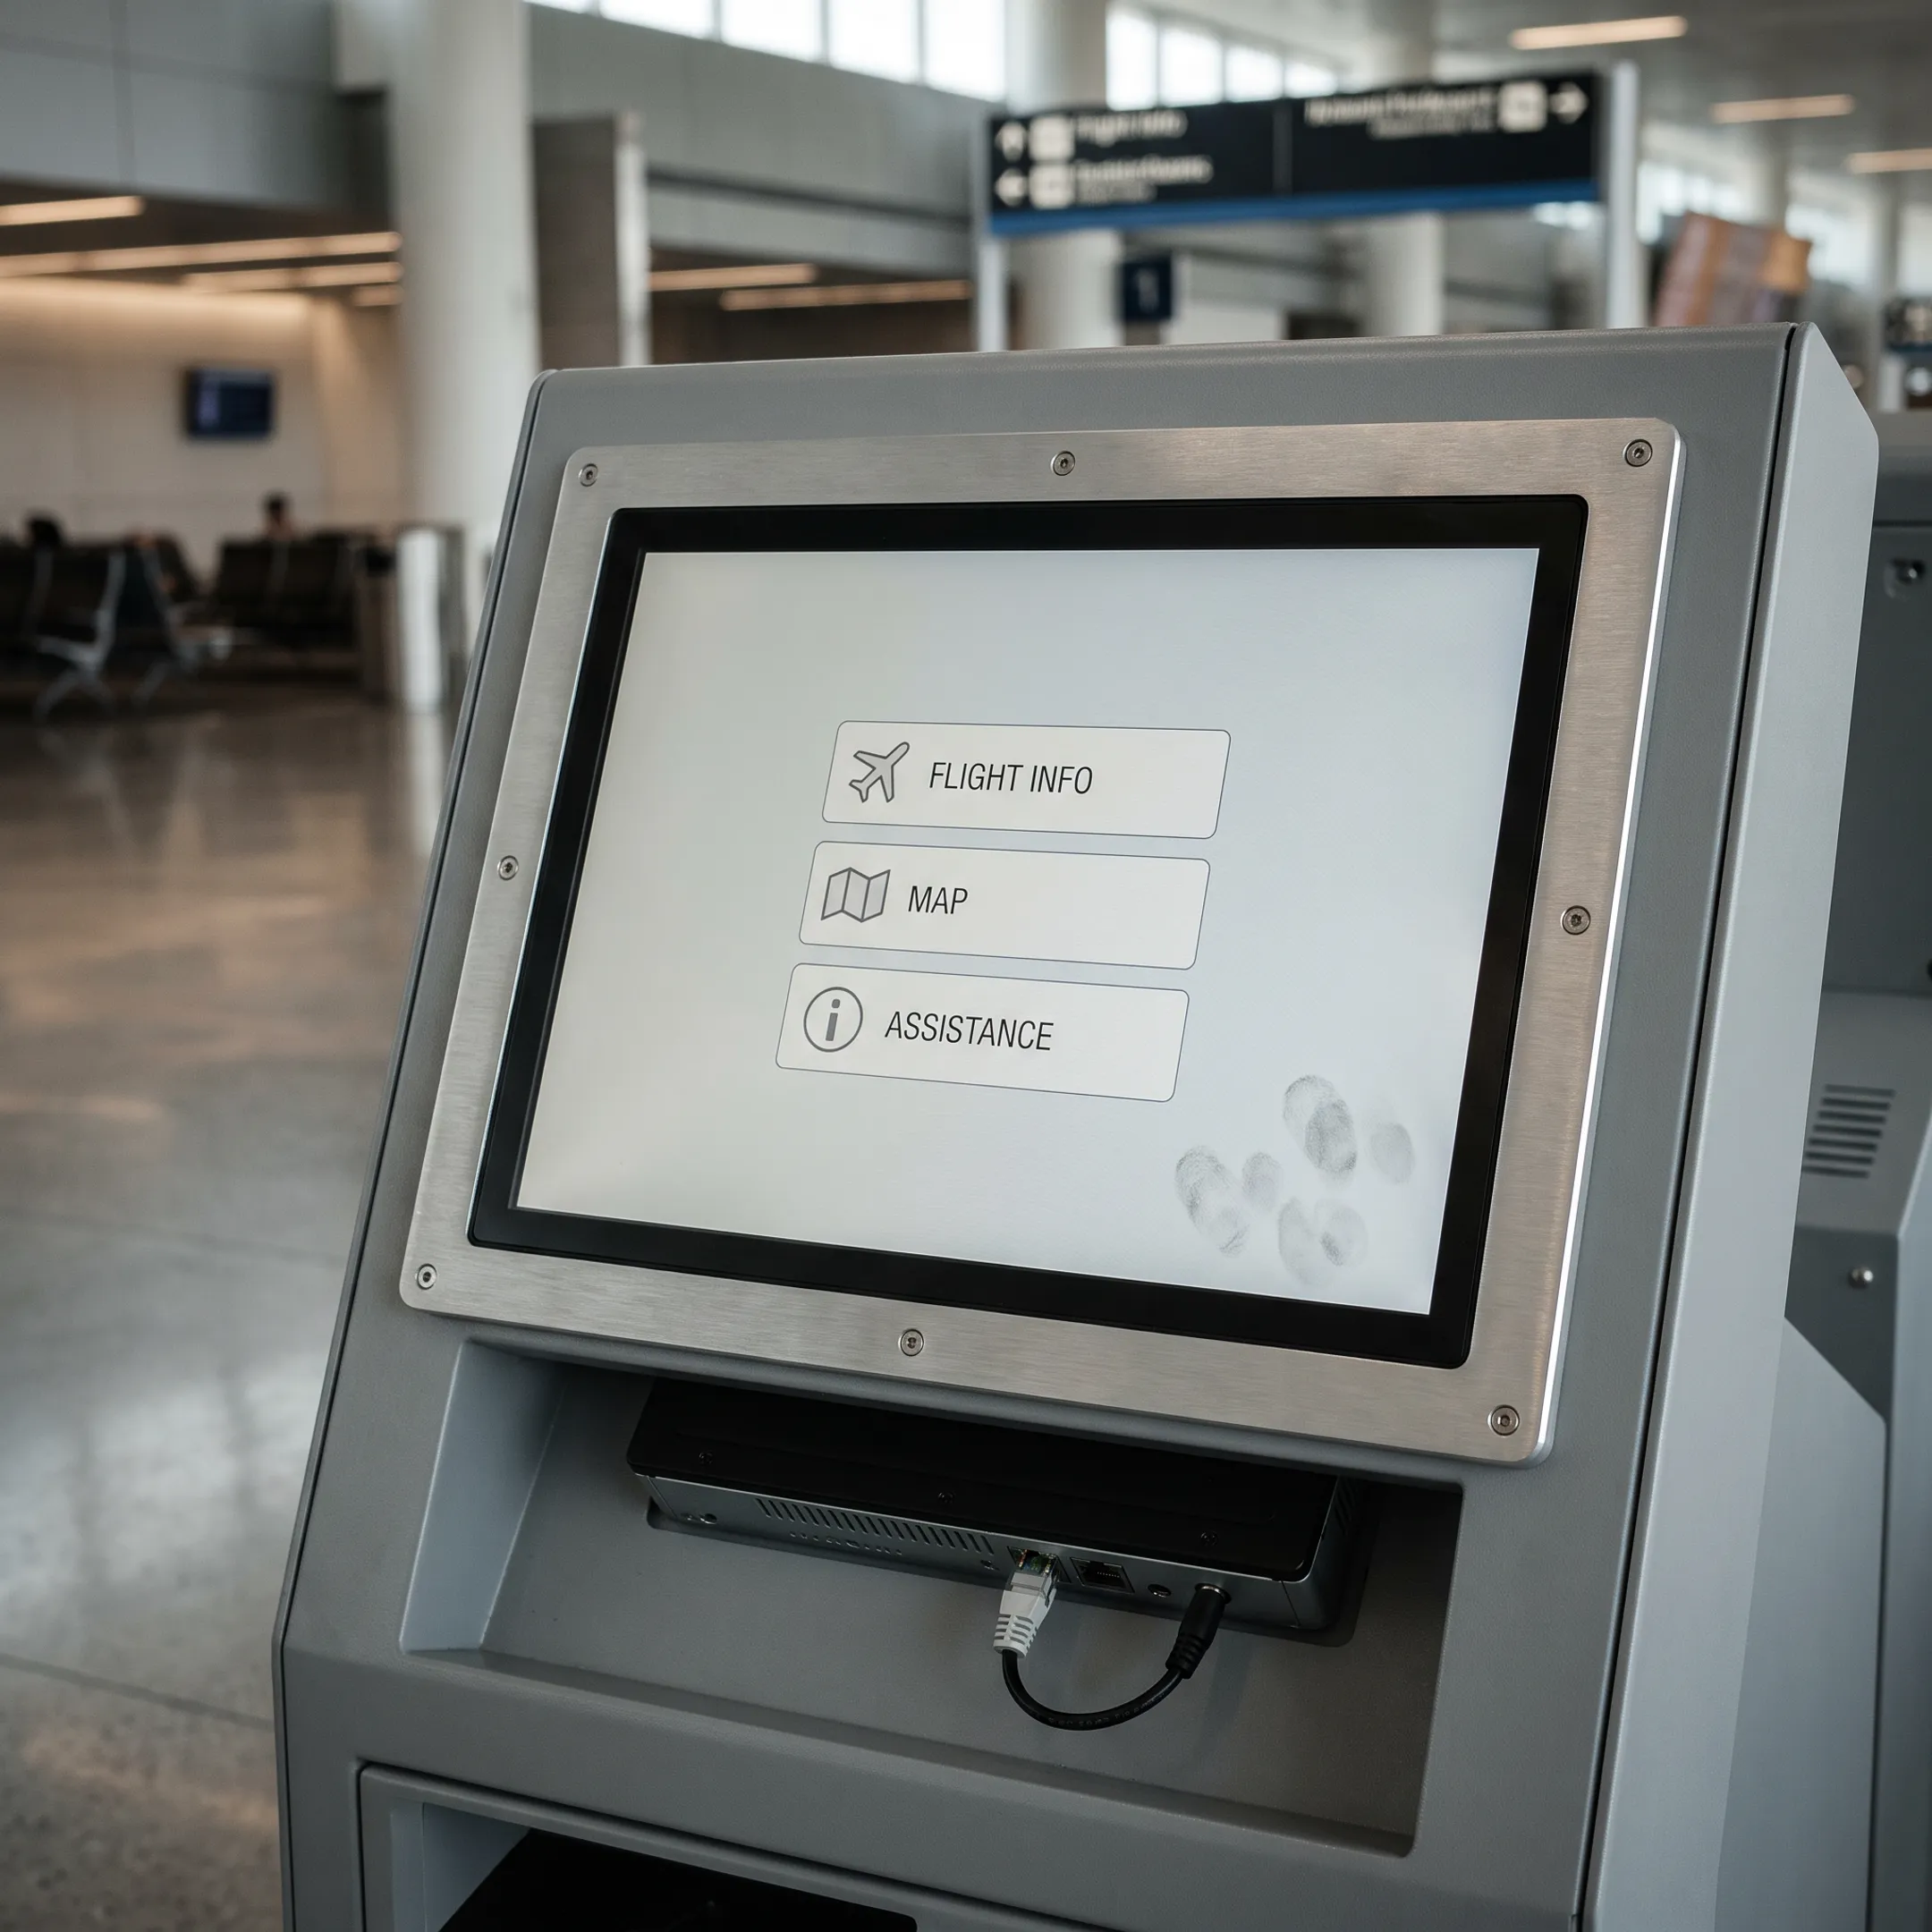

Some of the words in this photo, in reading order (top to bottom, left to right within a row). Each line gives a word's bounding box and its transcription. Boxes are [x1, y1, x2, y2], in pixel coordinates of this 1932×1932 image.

[928, 761, 1024, 792] FLIGHT
[1030, 765, 1093, 794] INFO
[908, 885, 968, 915] MAP
[885, 1011, 1055, 1051] ASSISTANCE
